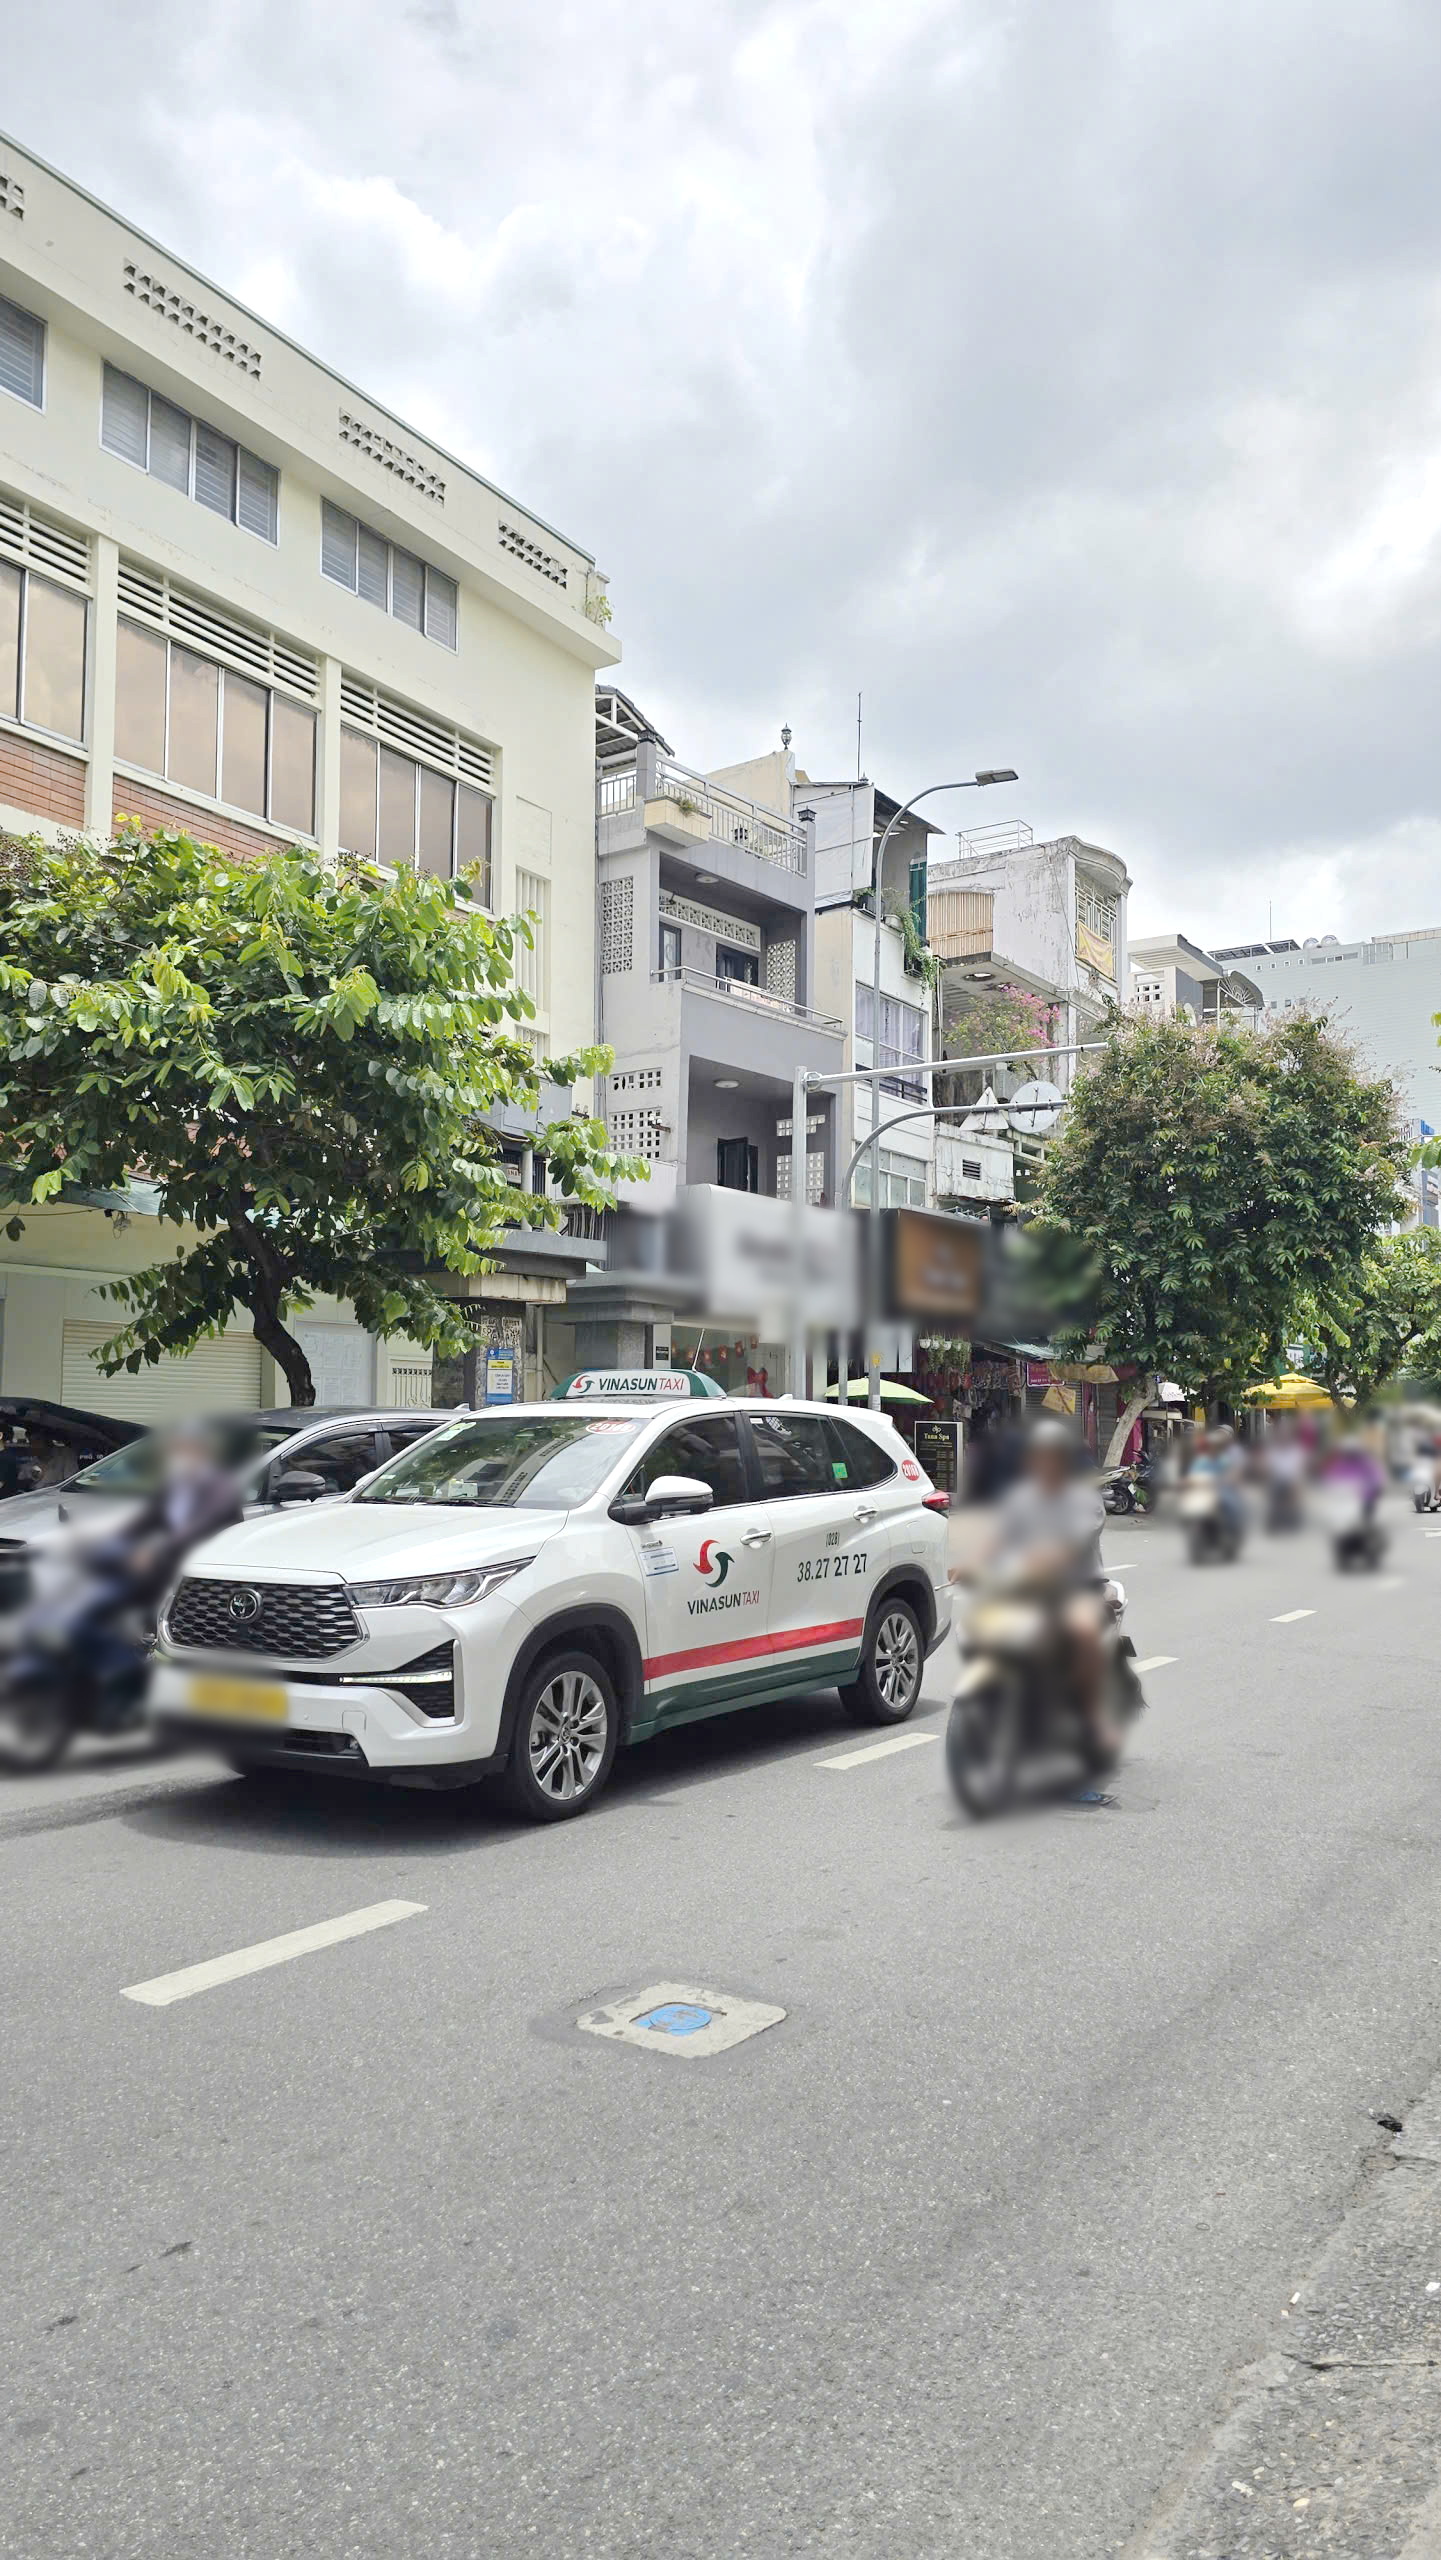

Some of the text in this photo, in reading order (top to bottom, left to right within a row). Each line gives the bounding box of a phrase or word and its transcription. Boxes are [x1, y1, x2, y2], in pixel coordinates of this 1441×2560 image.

[938, 1433, 950, 1442] Spa
[825, 1531, 840, 1547] (028)
[797, 1553, 867, 1582] 38.27 27 27
